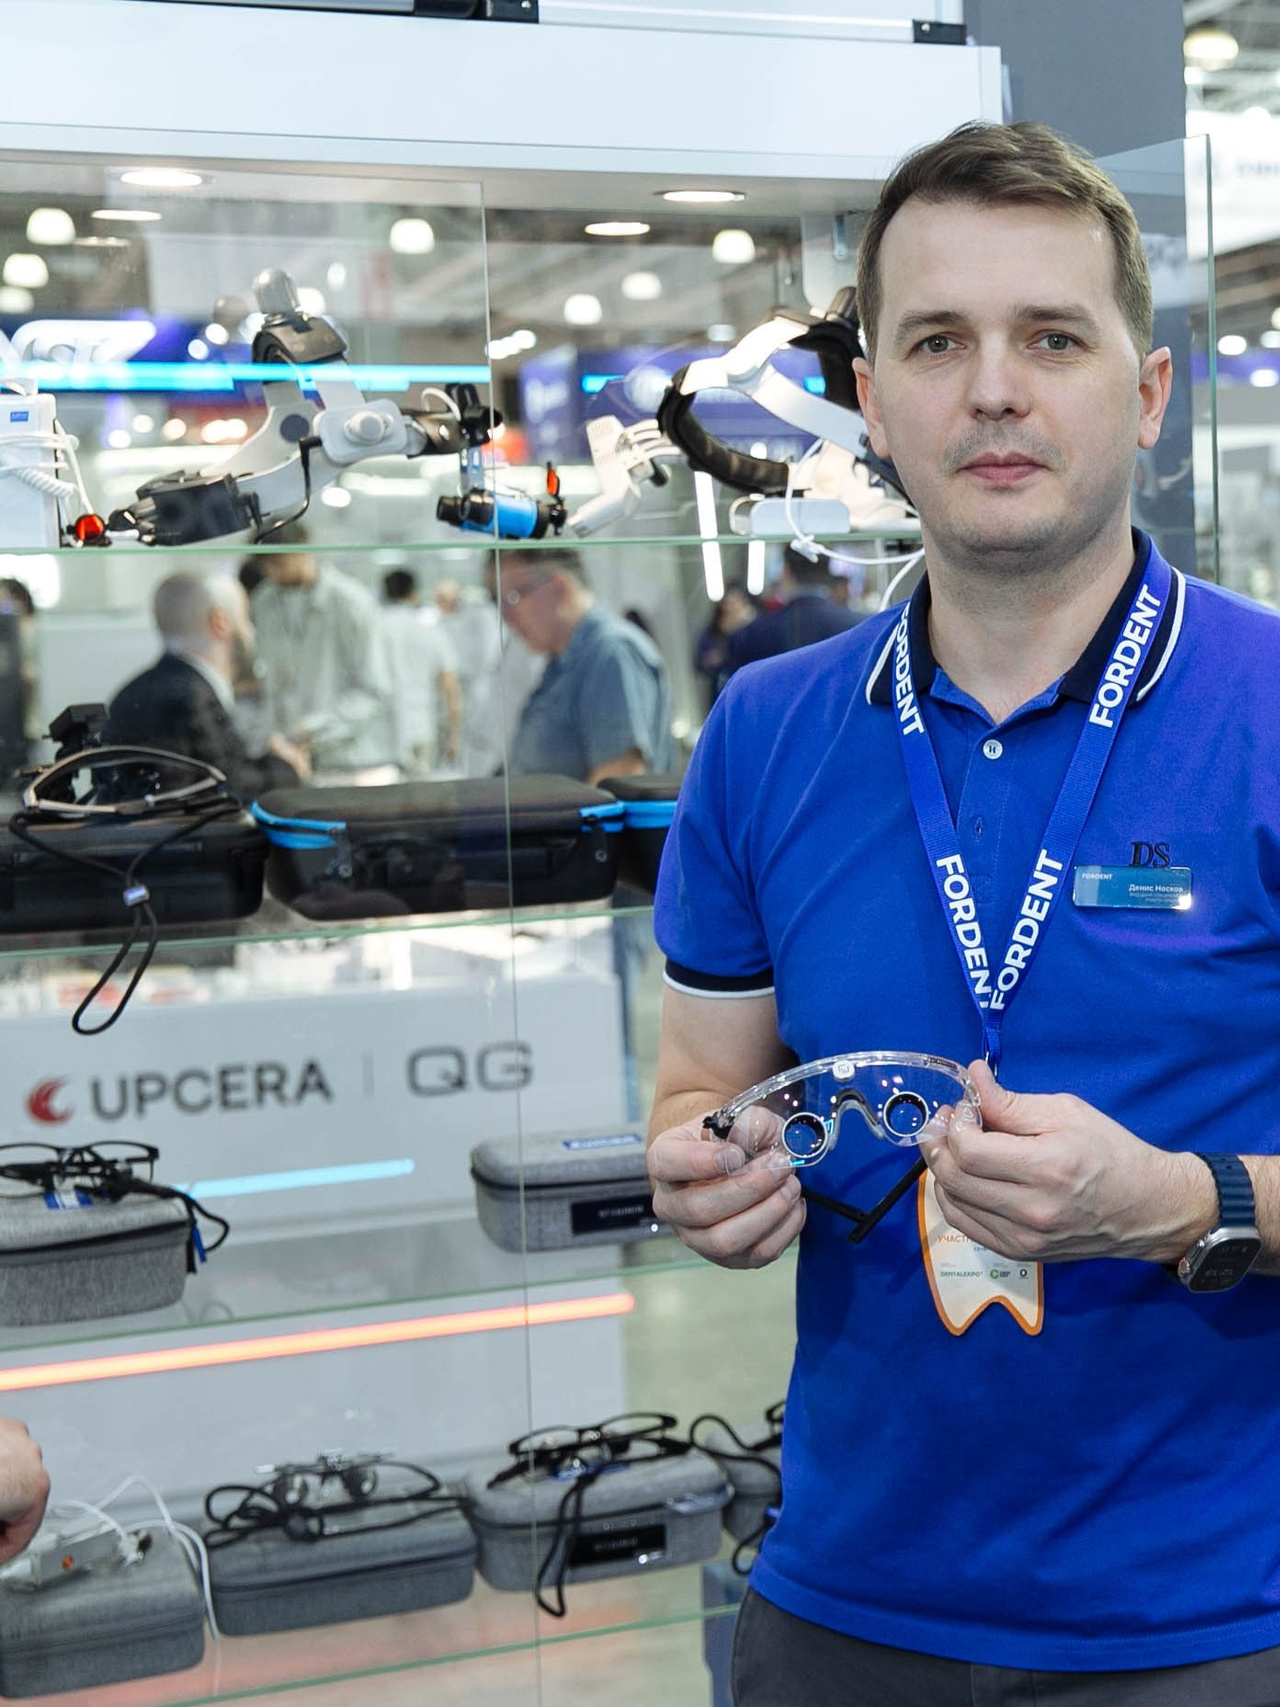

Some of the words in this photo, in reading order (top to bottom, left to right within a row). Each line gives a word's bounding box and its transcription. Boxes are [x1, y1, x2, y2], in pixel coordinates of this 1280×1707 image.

[896, 600, 925, 736] FORDENT
[1089, 583, 1162, 728] FORDENT
[1081, 872, 1113, 881] FORDENT
[1128, 884, 1154, 892] Денис
[1130, 841, 1171, 868] DS
[989, 848, 1064, 1010] FORDENT
[90, 1057, 332, 1121] UPCERA
[407, 1041, 534, 1096] QG
